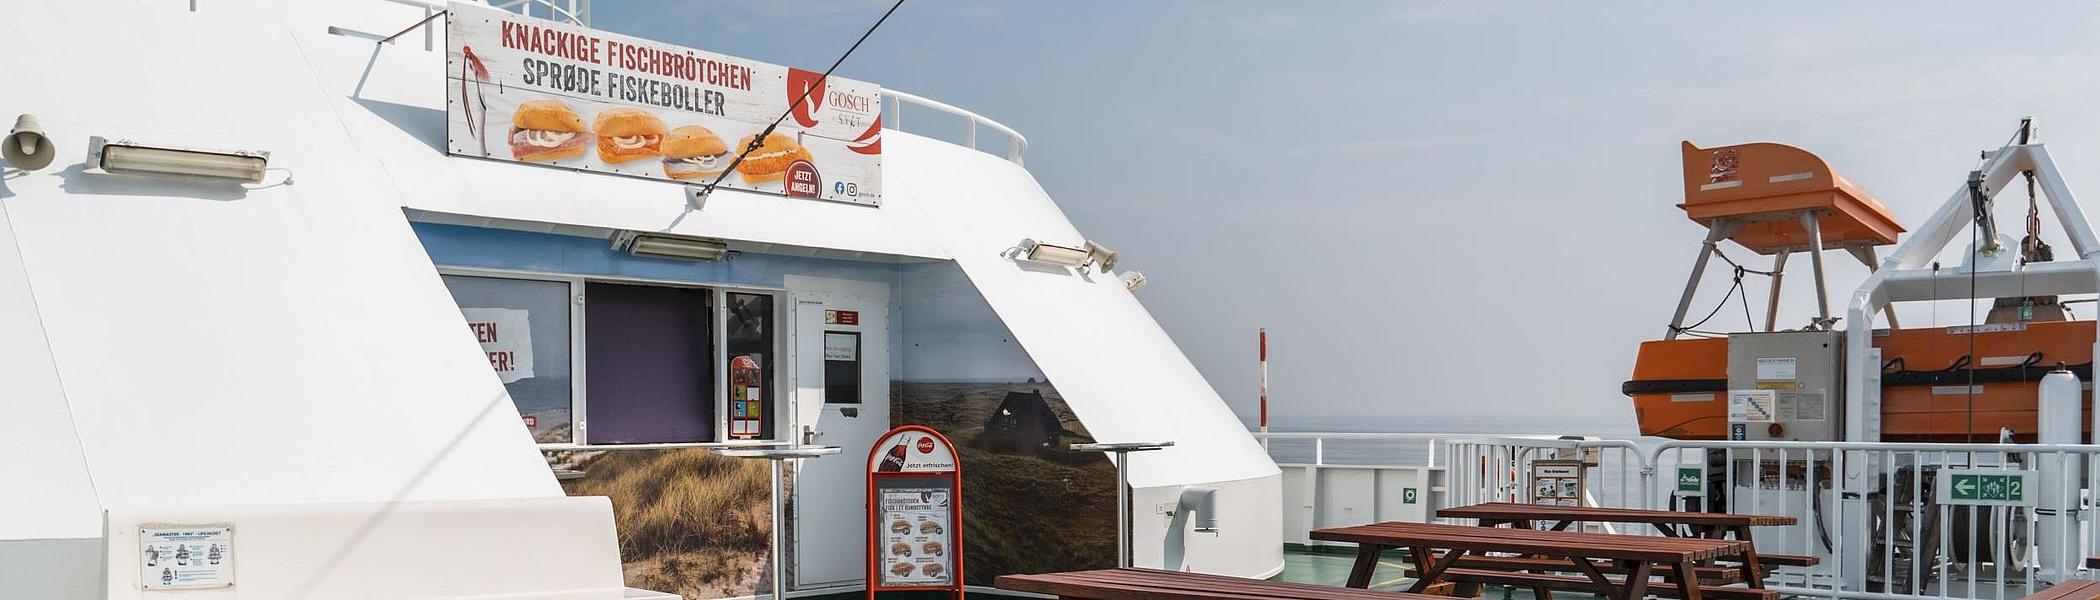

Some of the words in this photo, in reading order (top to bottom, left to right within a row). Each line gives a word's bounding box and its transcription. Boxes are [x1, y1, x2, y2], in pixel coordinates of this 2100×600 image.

[501, 20, 601, 65] KNACKIGE
[607, 41, 752, 91] FISCHBRÖTCHEN
[522, 58, 601, 97] SPRØDE
[608, 73, 726, 117] FISKEBOLLER
[828, 90, 870, 113] GOSCH
[794, 170, 812, 182] JETZT
[486, 351, 514, 371] ER!
[2011, 481, 2020, 496] 2
